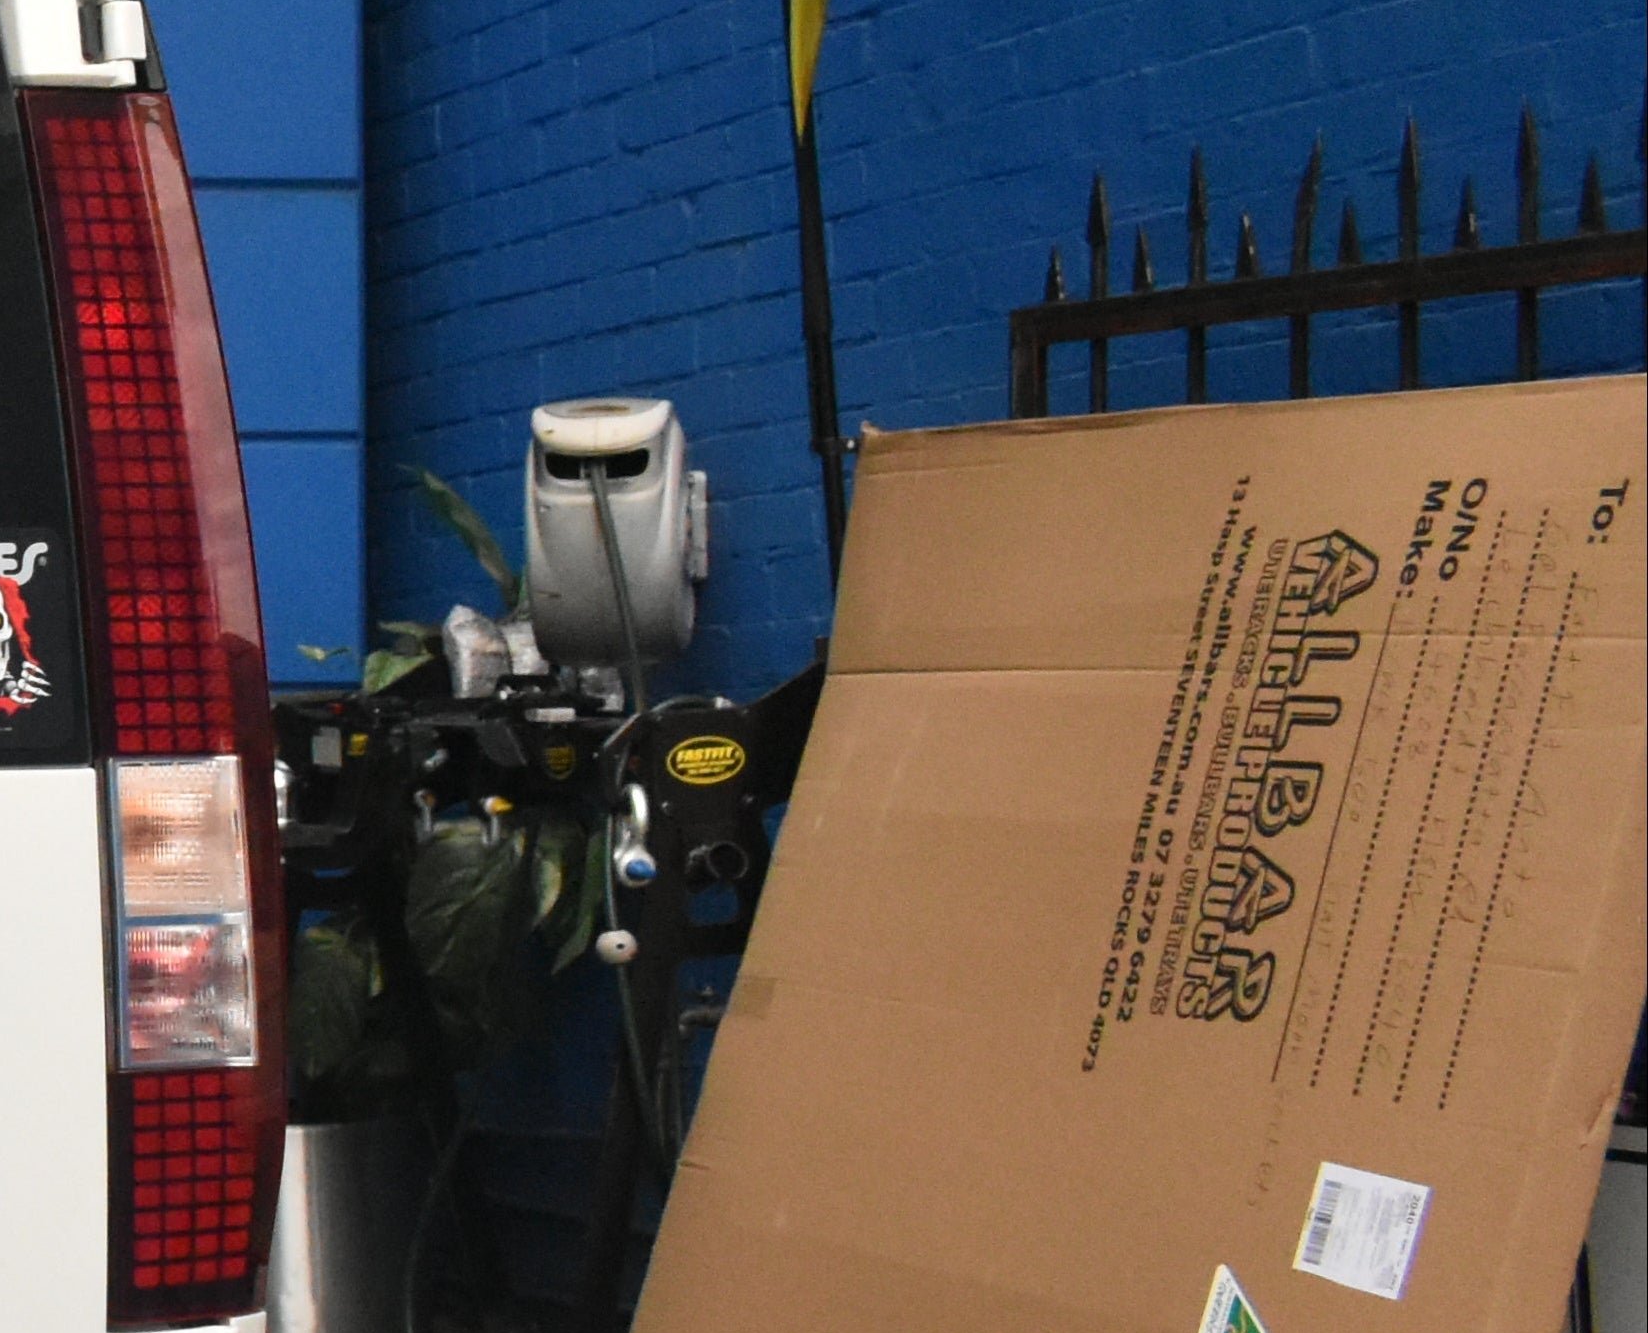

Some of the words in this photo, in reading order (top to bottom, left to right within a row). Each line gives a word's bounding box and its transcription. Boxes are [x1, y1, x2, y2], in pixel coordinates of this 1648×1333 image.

[1233, 475, 1250, 501] 13
[1585, 477, 1631, 545] To:
[1394, 479, 1453, 600] Make:
[1438, 477, 1488, 582] O/No
[1191, 571, 1220, 641] Street
[1165, 524, 1257, 815] www.allbars.com.au
[1149, 648, 1199, 788] SEVENTEEN
[1204, 529, 1379, 1022] ALLBAR
[1130, 792, 1160, 864] MILES
[1157, 828, 1175, 864] 07
[1110, 869, 1141, 951] ROCKS
[1136, 870, 1165, 944] 3279
[1097, 956, 1120, 1008] QLD
[1116, 952, 1146, 1023] 6422
[1081, 1014, 1106, 1072] 4073
